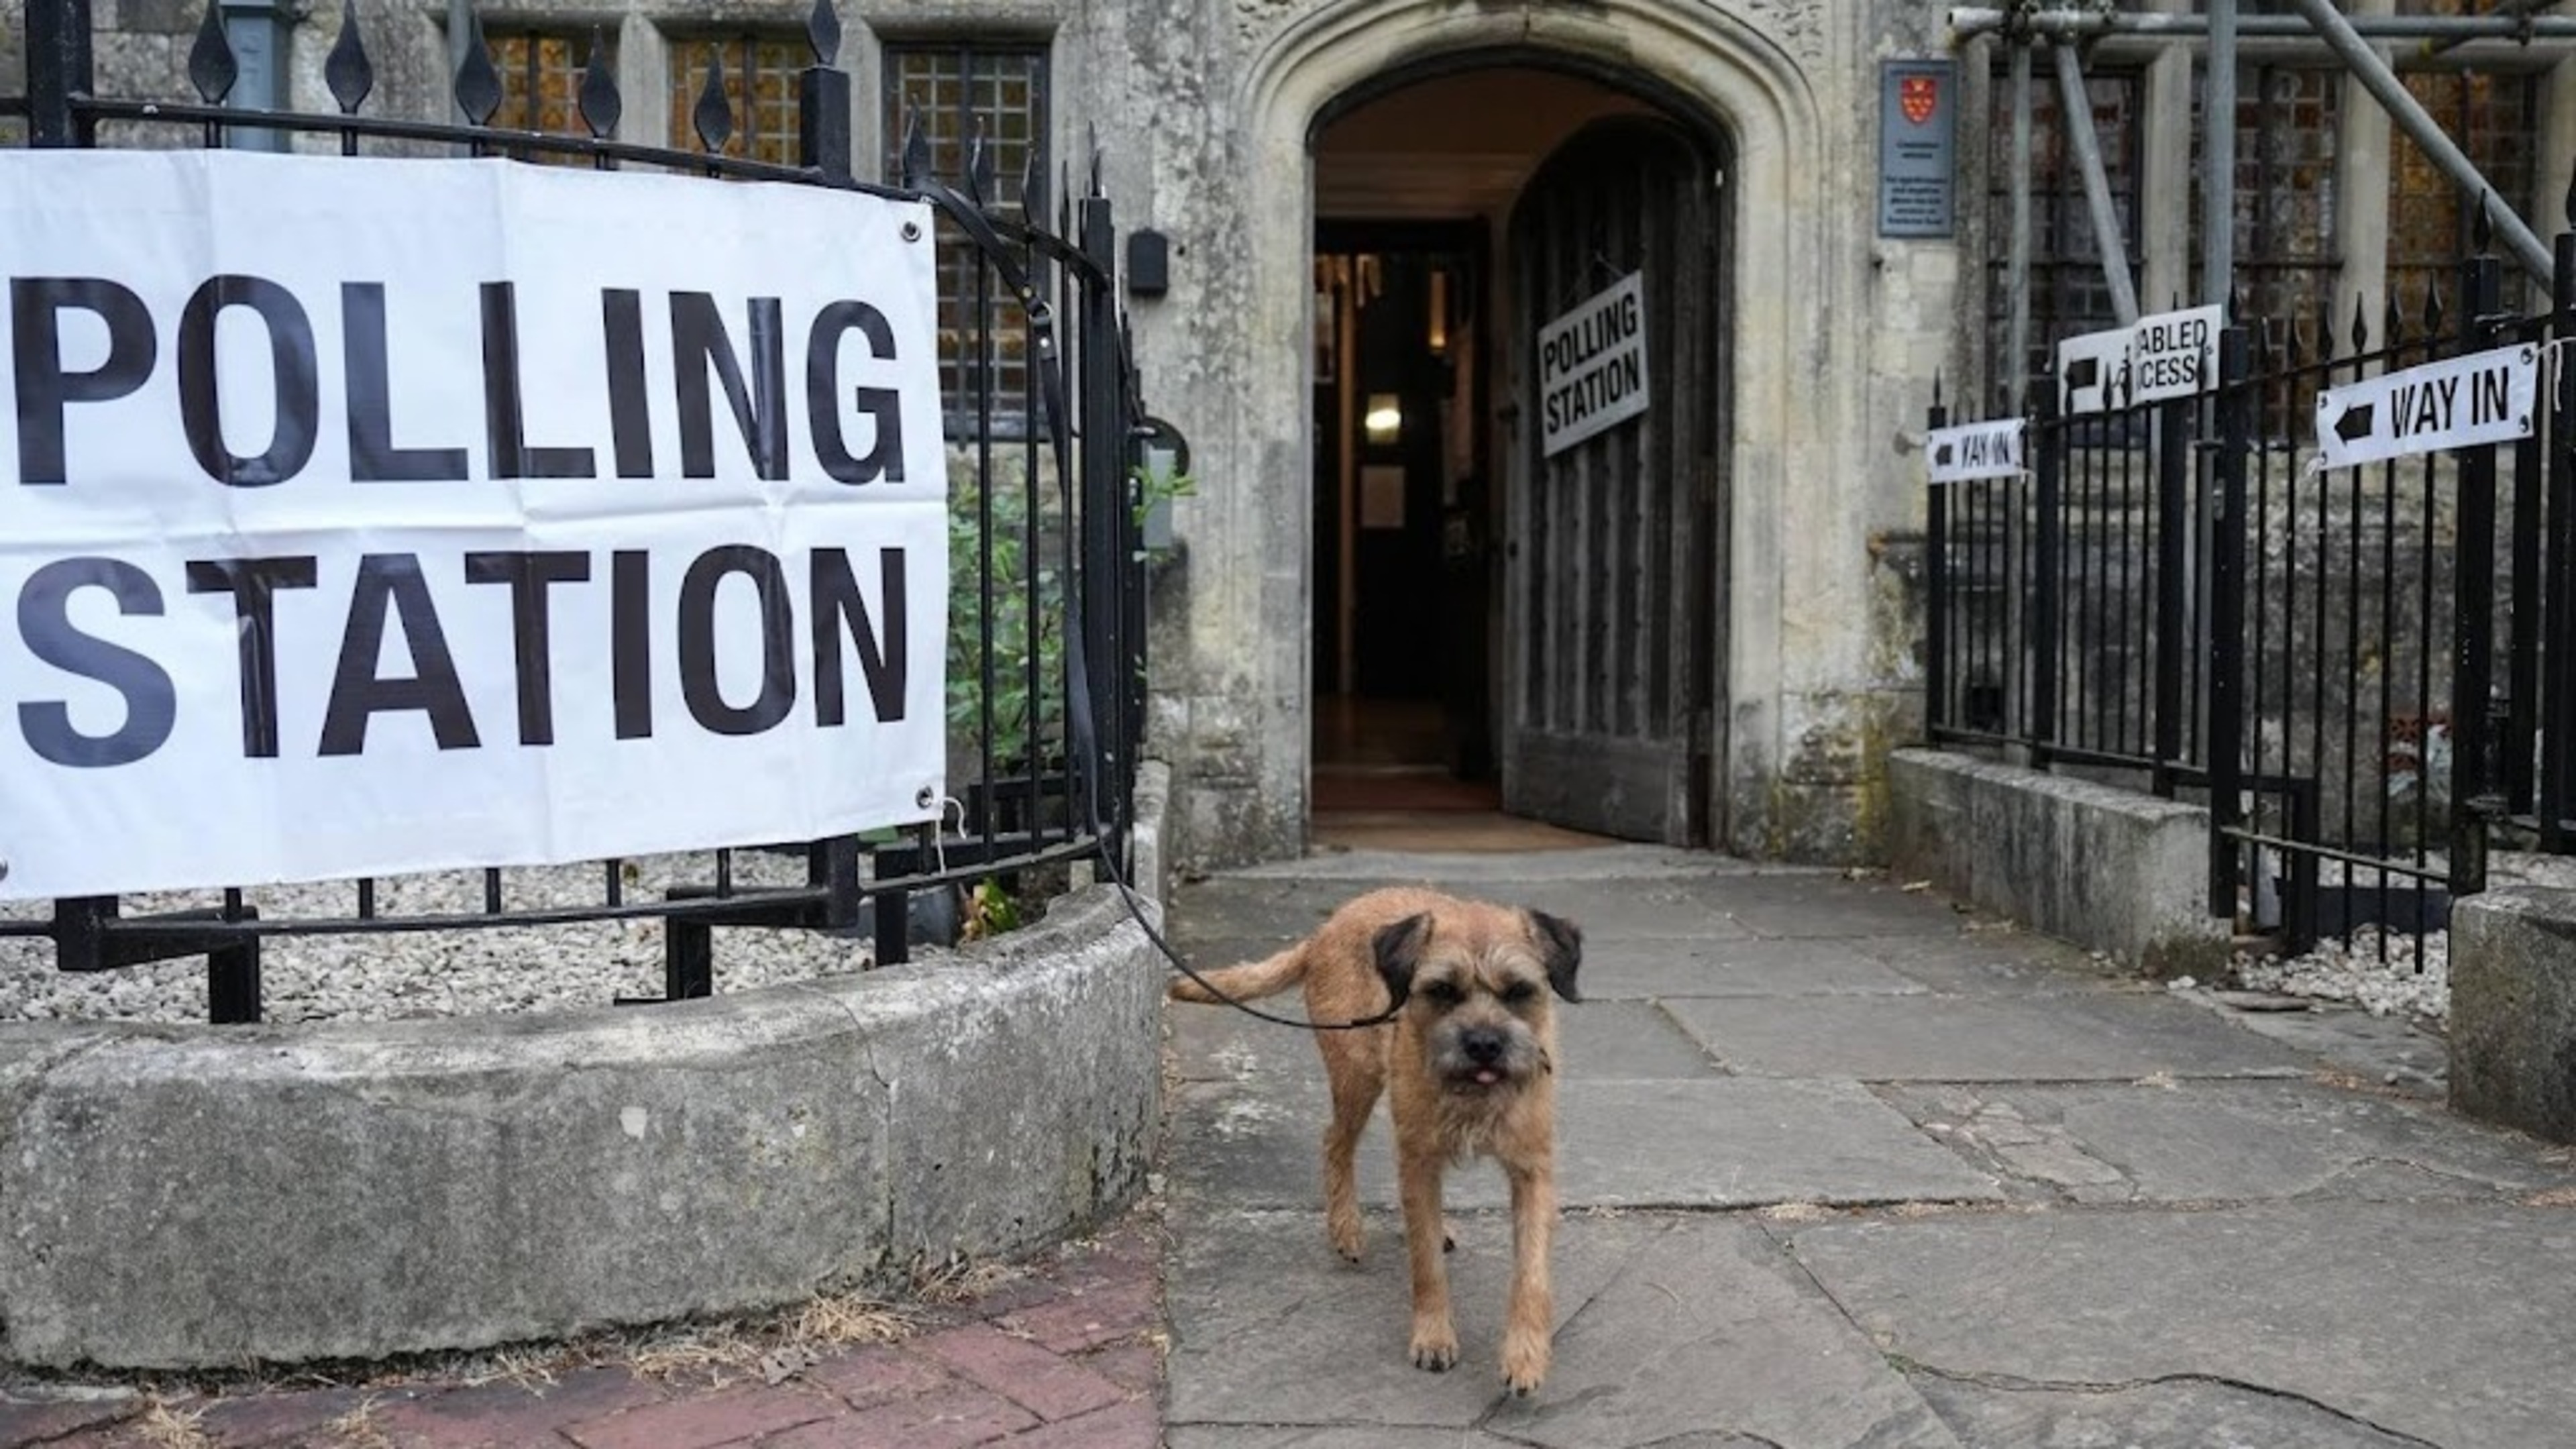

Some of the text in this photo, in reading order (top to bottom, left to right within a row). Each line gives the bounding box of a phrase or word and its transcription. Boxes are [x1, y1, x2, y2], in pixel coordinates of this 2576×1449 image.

[10, 274, 906, 486] POLLING
[1544, 292, 1637, 383] POLLING
[2137, 354, 2195, 390] CESS
[1546, 347, 1640, 435] STATION
[2391, 366, 2508, 439] WAY IN
[16, 543, 906, 768] STATION
